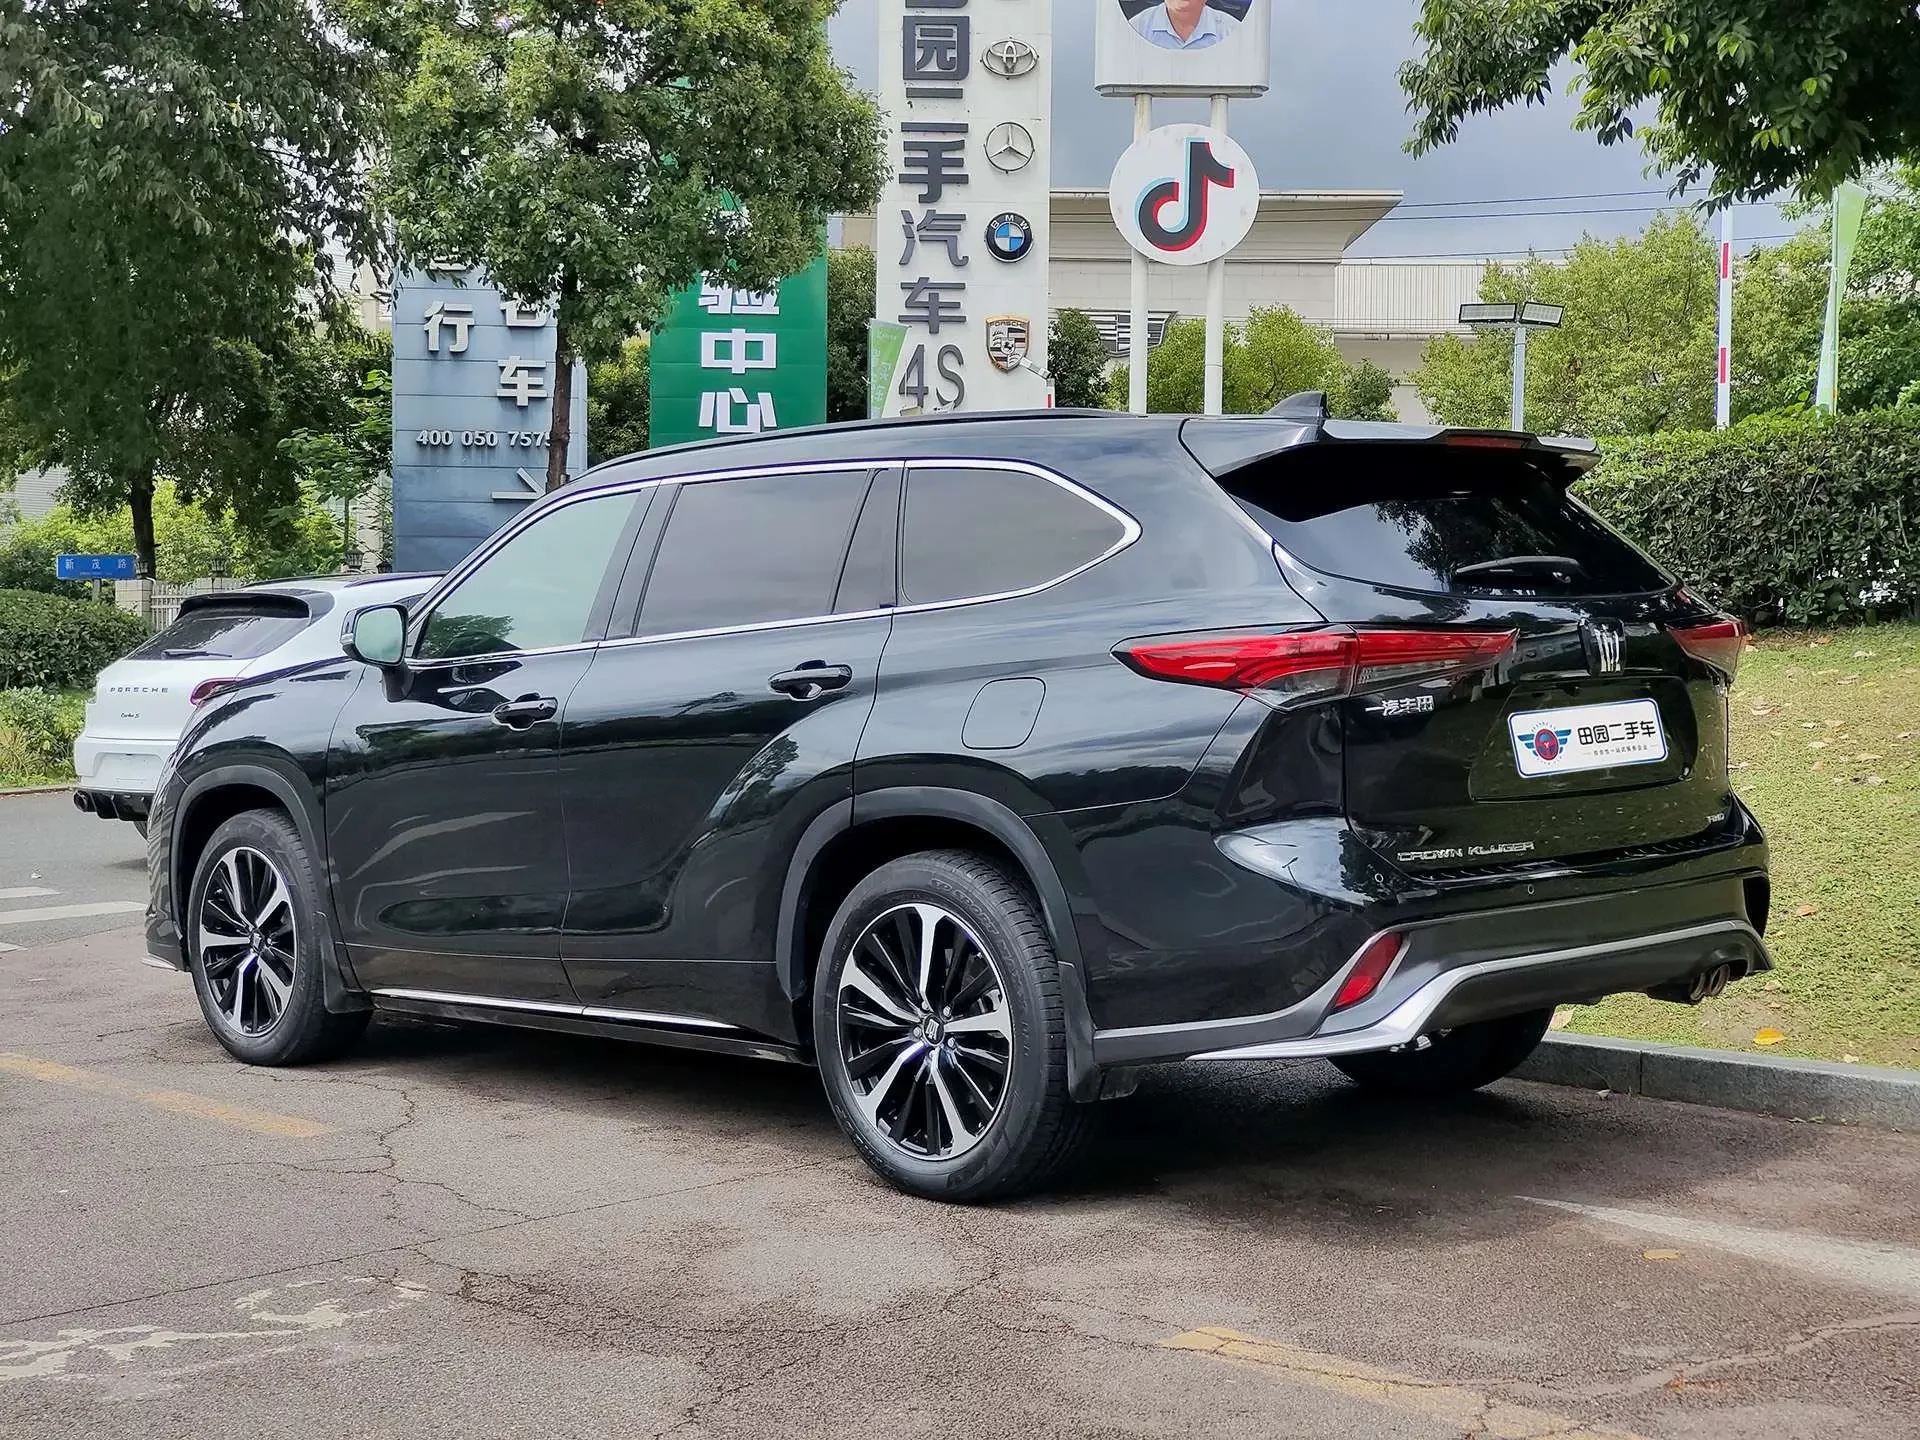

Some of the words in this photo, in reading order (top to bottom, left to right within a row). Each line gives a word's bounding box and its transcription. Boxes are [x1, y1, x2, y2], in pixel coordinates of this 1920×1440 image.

[898, 0, 969, 409] 园二手汽车4S
[991, 214, 1030, 230] BMW
[416, 430, 454, 447] 400
[461, 431, 498, 447] 050
[1577, 720, 1656, 746] 田园二手车
[1397, 848, 1463, 861] CROWN
[1467, 841, 1535, 856] KLUGER
